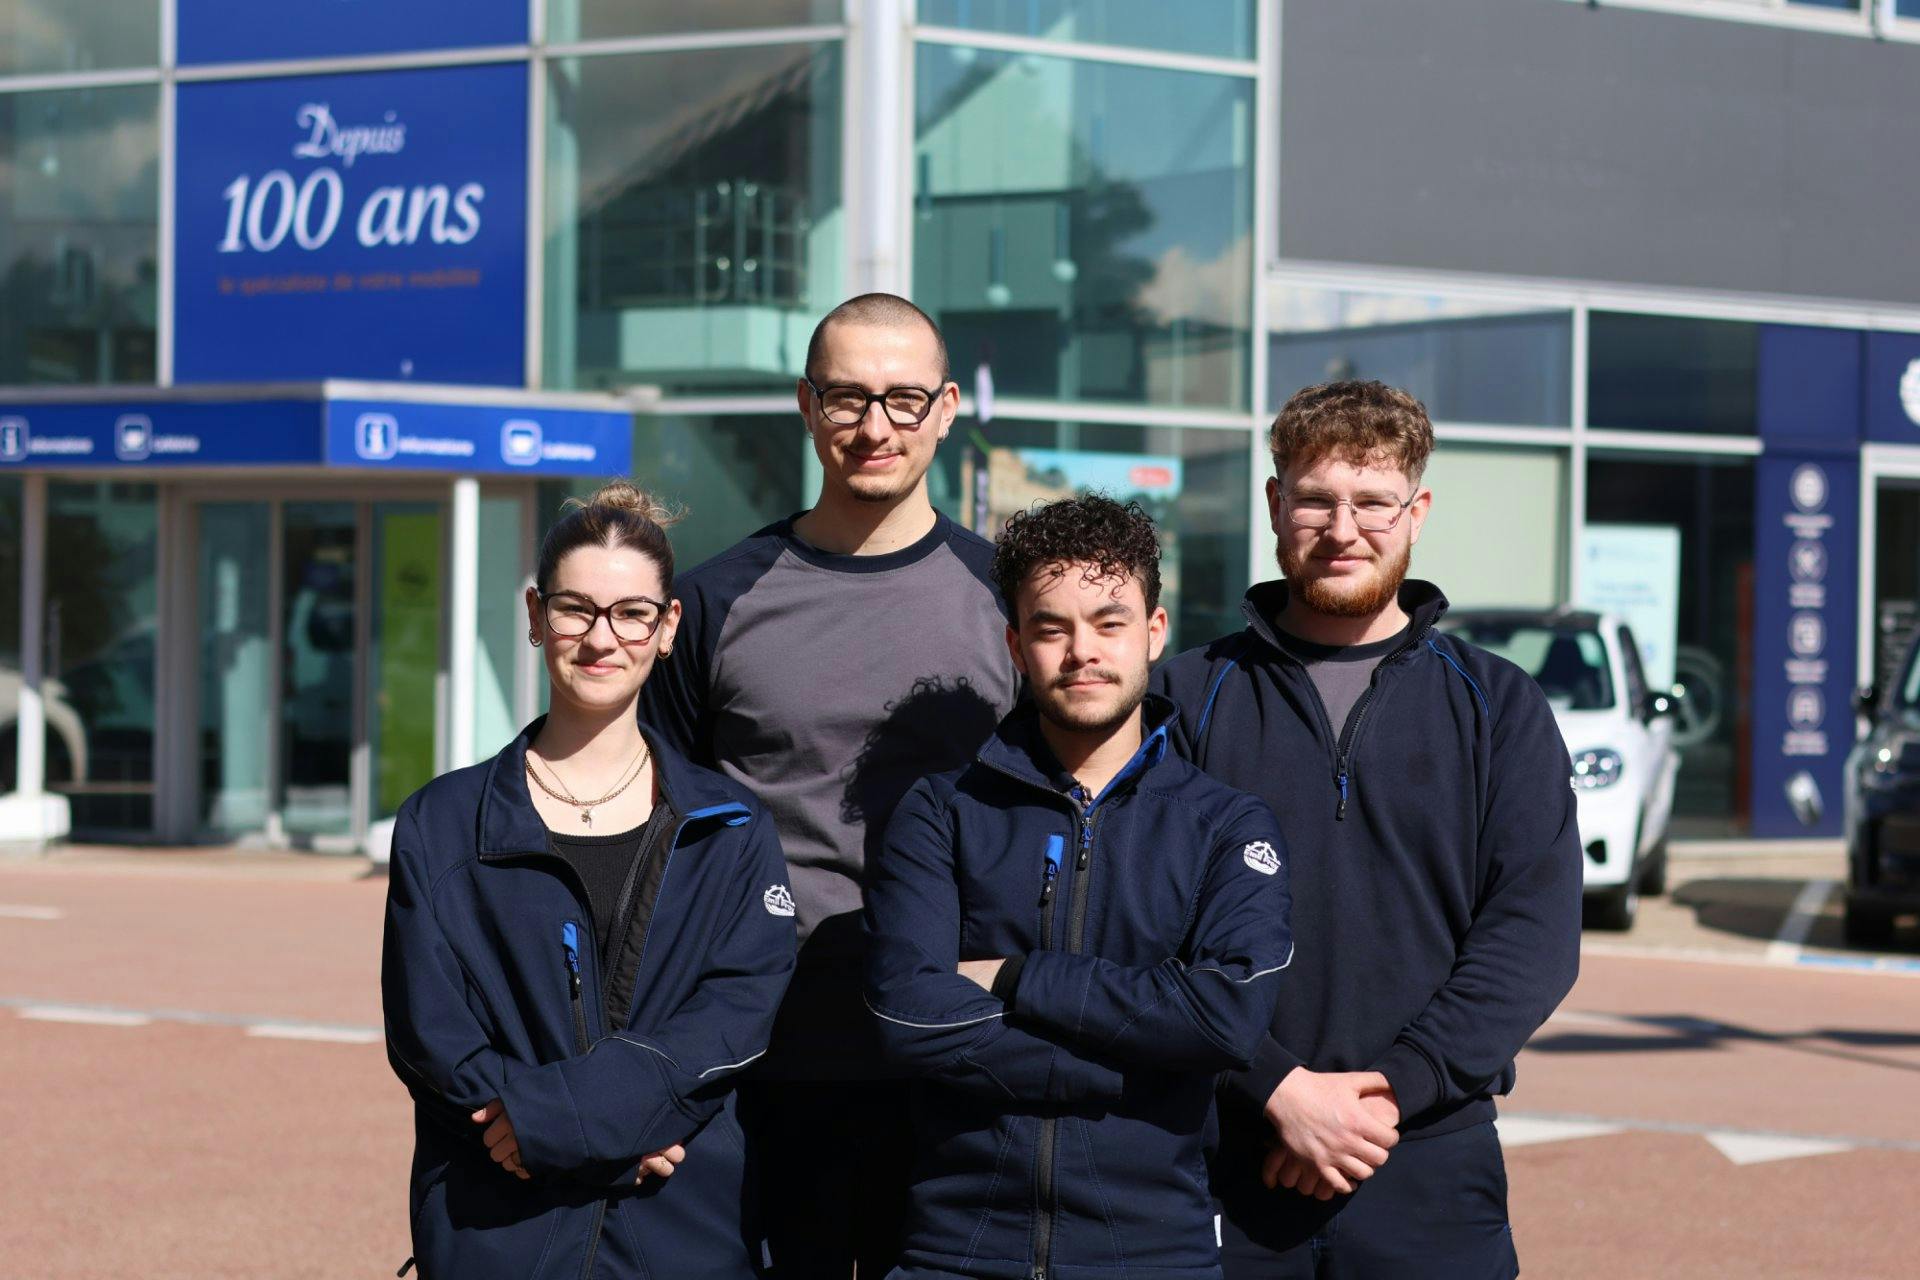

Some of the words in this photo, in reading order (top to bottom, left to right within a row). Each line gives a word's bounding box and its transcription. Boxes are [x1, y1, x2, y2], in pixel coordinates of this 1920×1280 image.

[294, 103, 405, 166] Depuis
[218, 168, 343, 252] 100
[357, 183, 484, 247] ans
